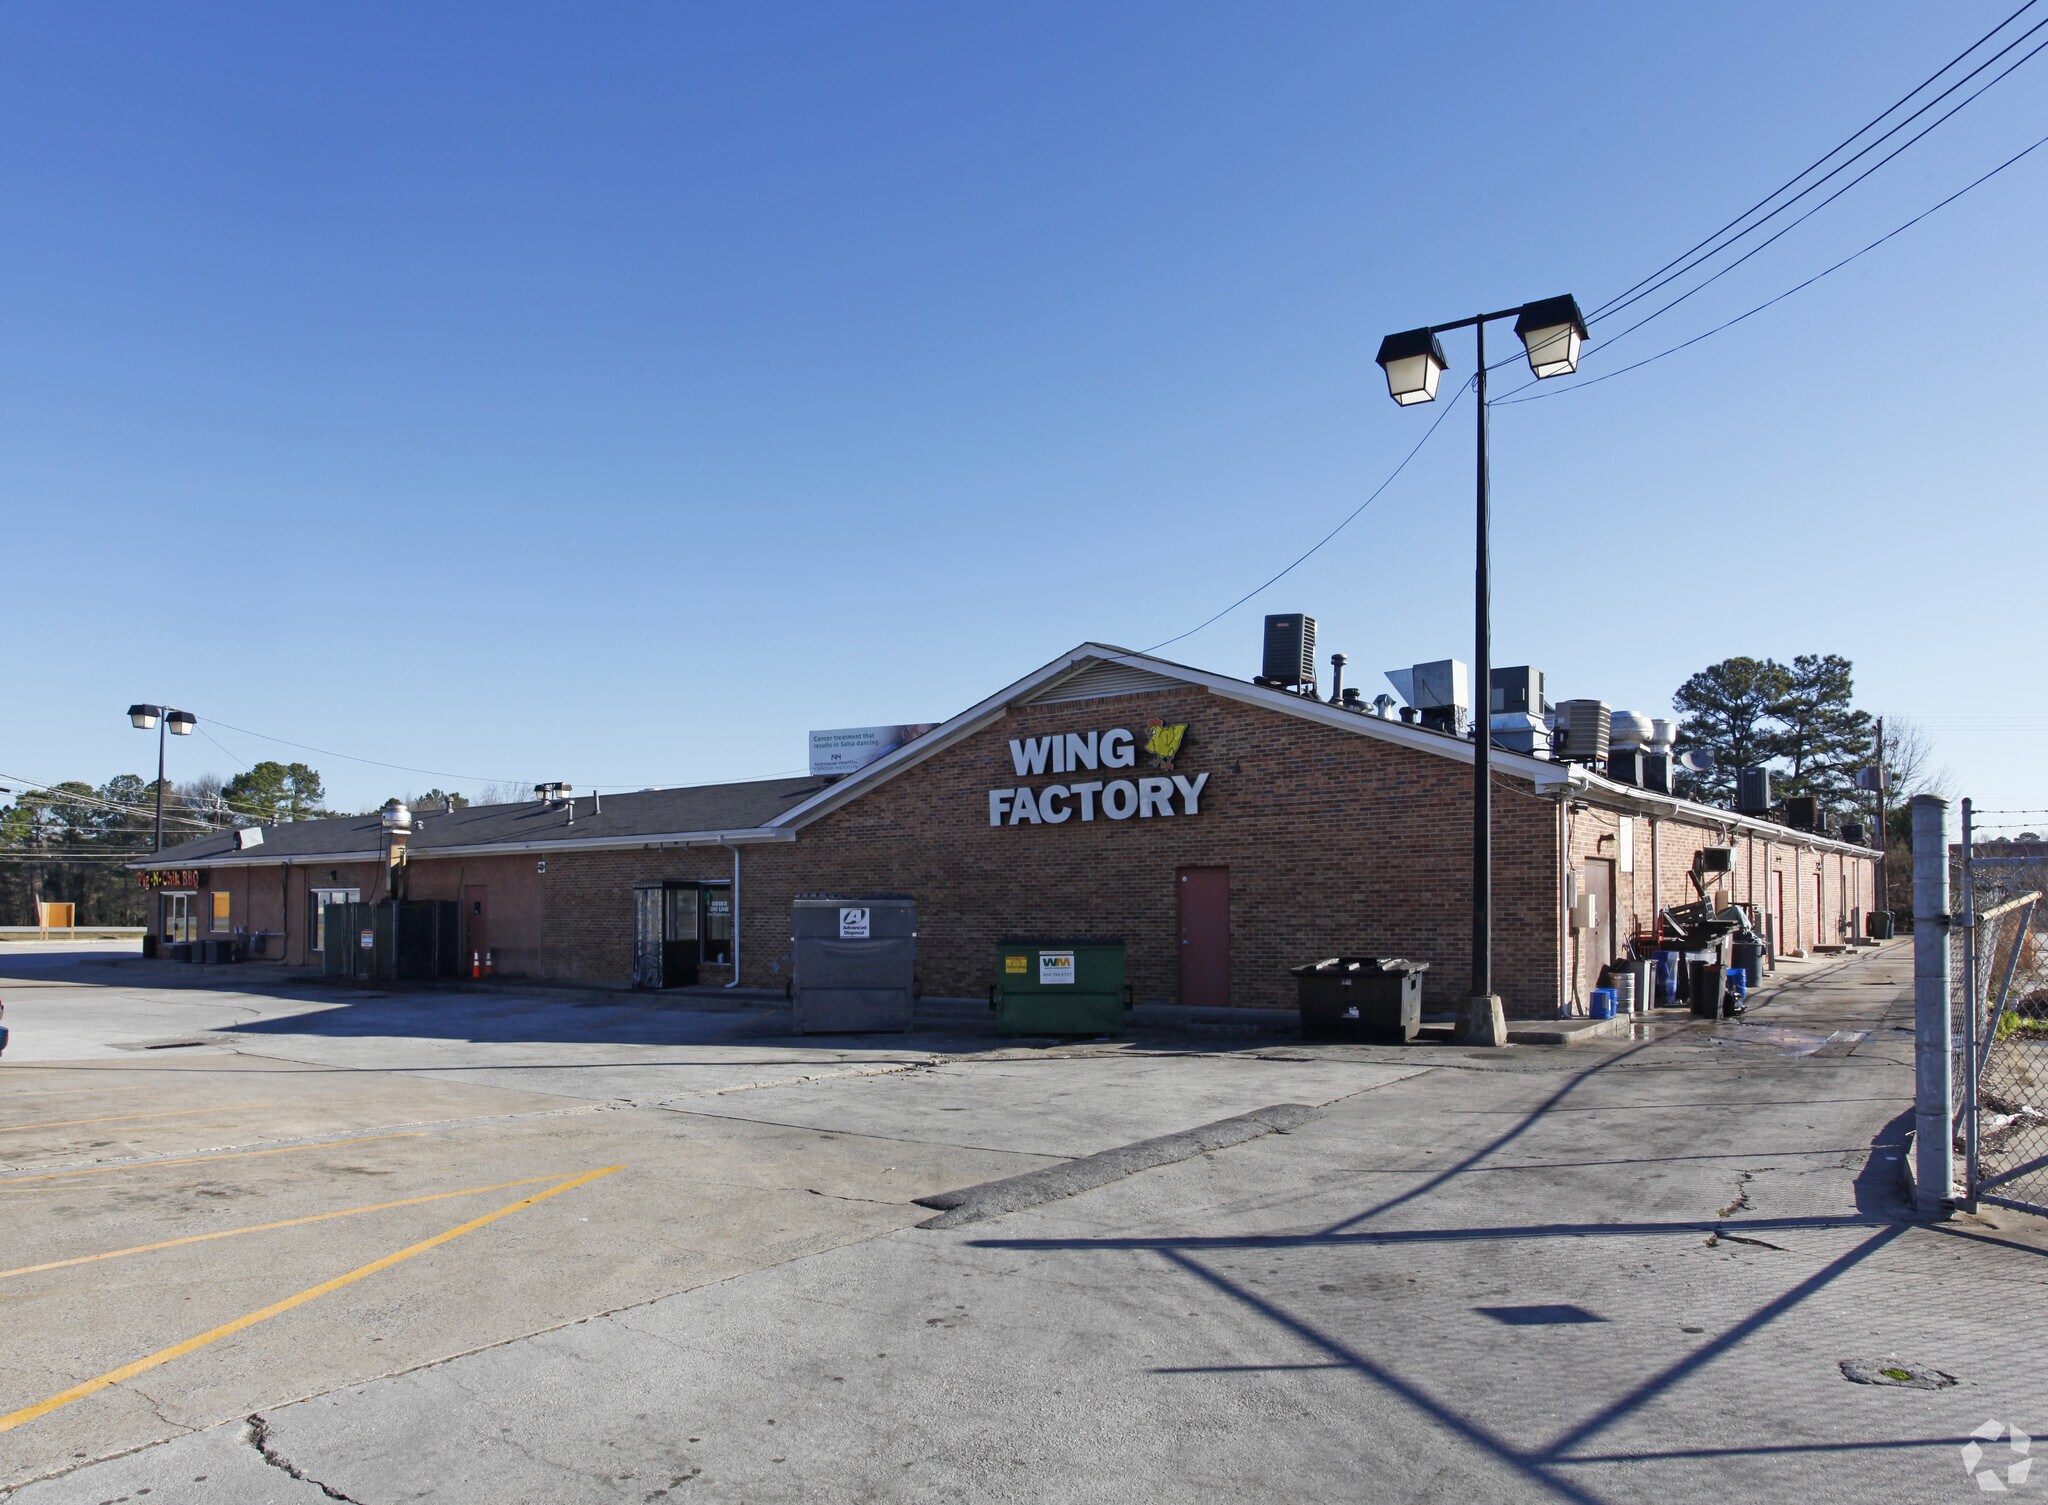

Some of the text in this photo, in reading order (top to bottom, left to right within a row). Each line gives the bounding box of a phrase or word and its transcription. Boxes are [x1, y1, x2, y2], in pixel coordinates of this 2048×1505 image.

[1009, 728, 1135, 776] WING
[988, 772, 1210, 827] FACTORY
[181, 869, 199, 889] BBQ
[1043, 958, 1071, 966] WM
